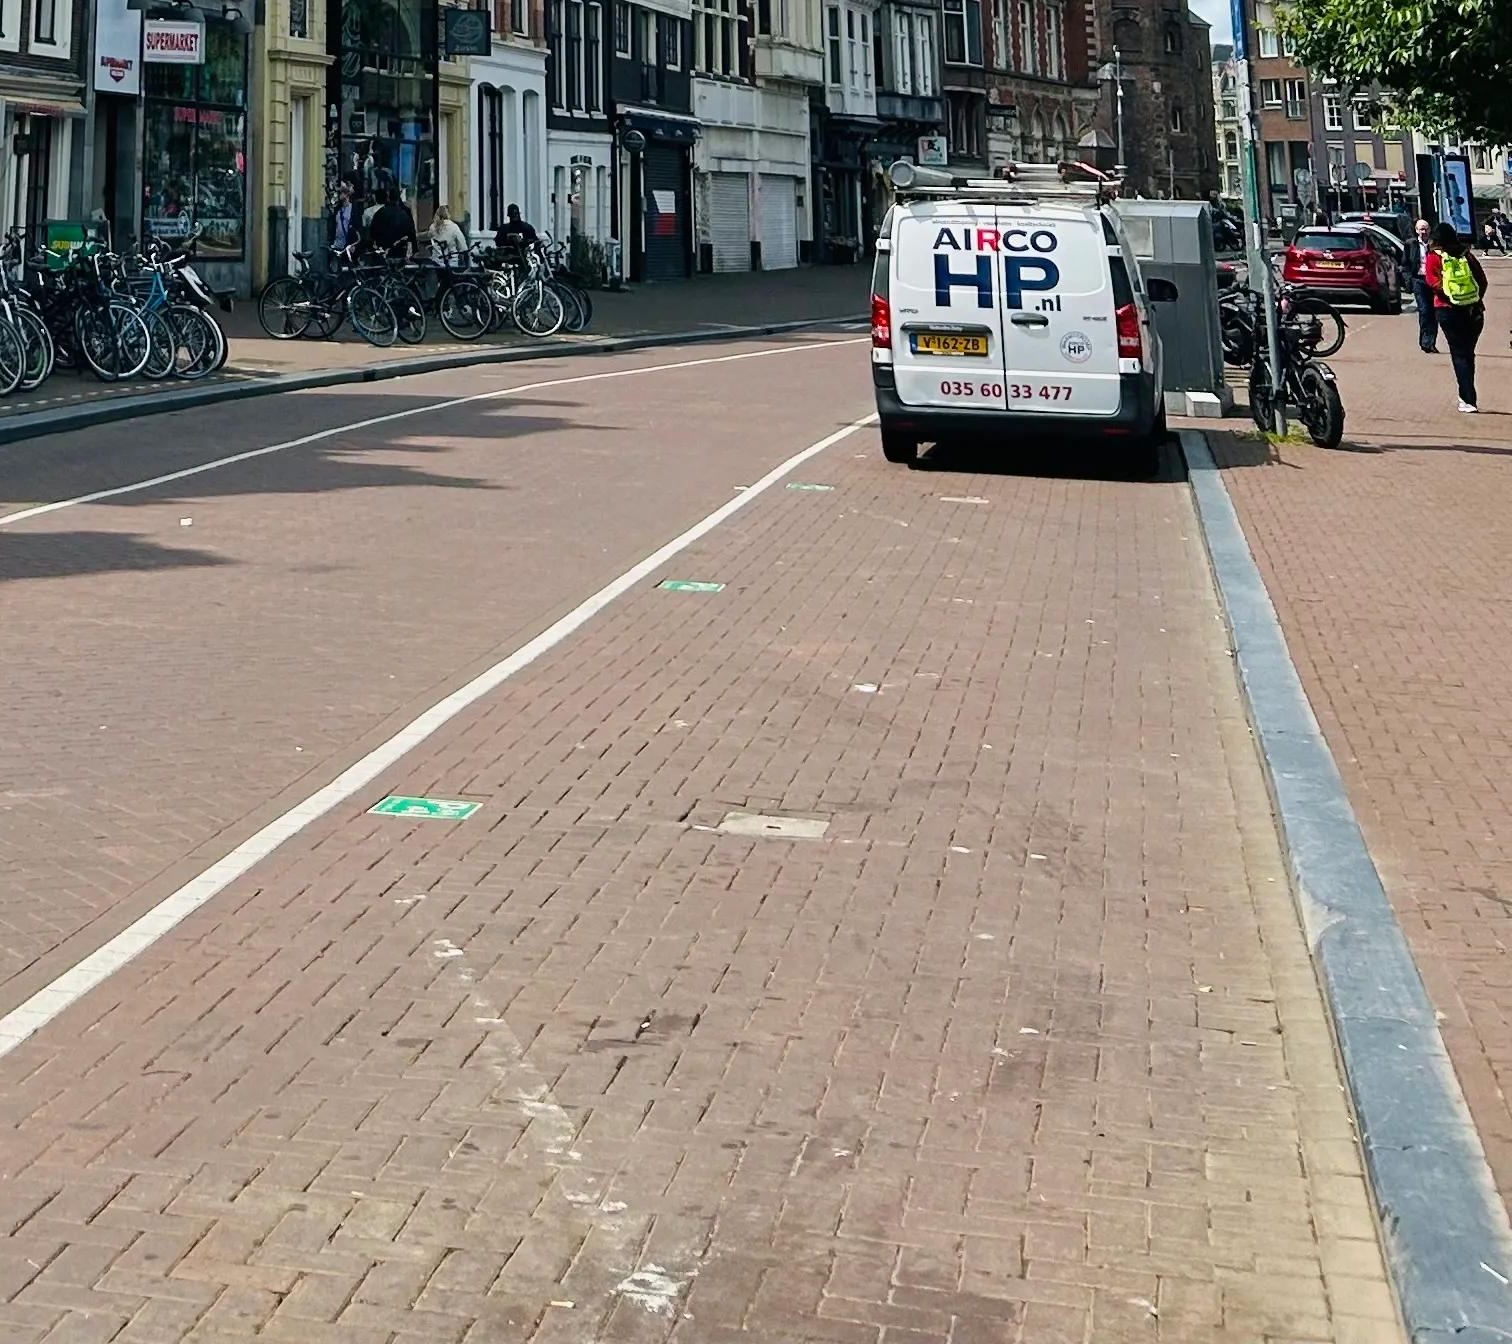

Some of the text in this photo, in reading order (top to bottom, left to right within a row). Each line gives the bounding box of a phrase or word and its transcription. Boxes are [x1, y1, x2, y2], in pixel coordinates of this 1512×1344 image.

[146, 31, 199, 52] SUPERMARKET
[932, 227, 1058, 253] AIRCO
[933, 253, 1060, 310] HP
[1035, 295, 1062, 312] .nl
[1068, 345, 1085, 354] HP
[940, 381, 1073, 401] 035 60 33 477
